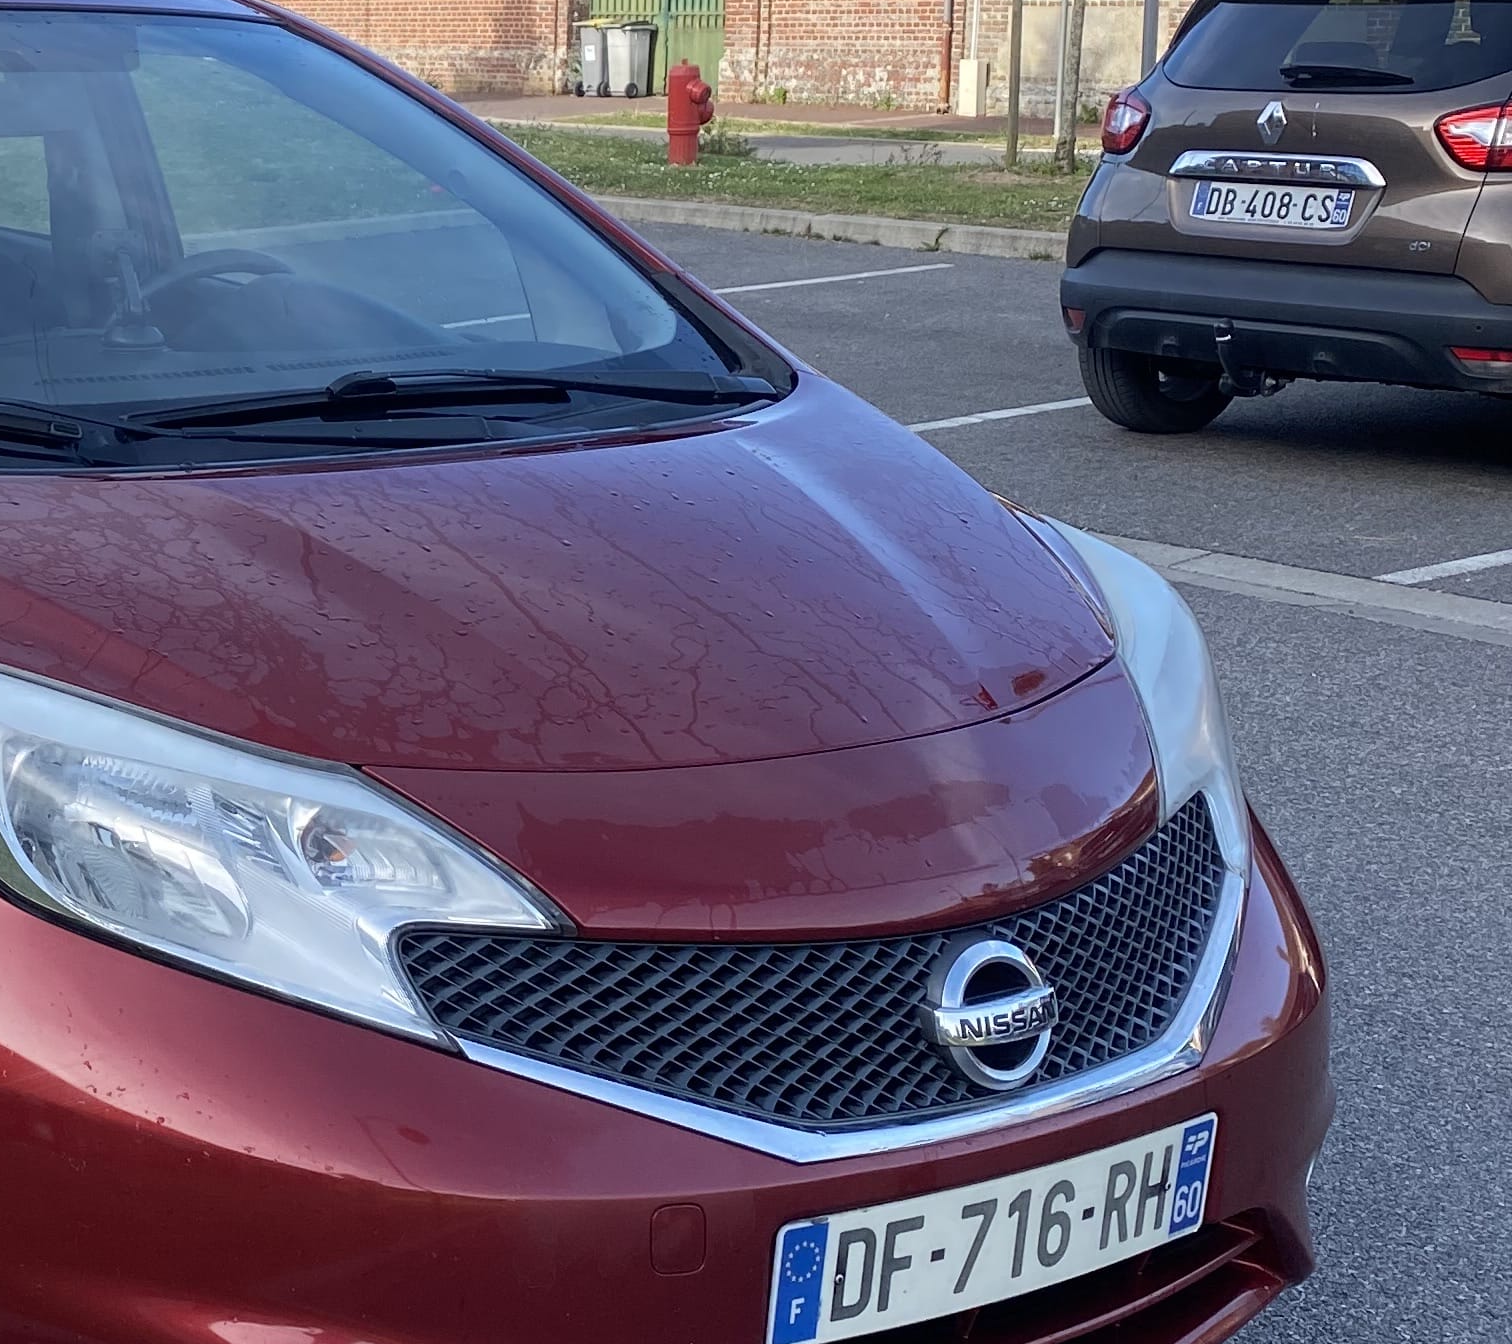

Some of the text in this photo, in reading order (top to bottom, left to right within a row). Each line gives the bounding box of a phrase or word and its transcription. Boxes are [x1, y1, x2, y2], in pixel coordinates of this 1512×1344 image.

[1202, 158, 1338, 177] CAPTUR
[1332, 208, 1347, 223] 60
[959, 995, 1055, 1040] NISSAN
[789, 1297, 805, 1325] F
[1173, 1180, 1202, 1224] 60
